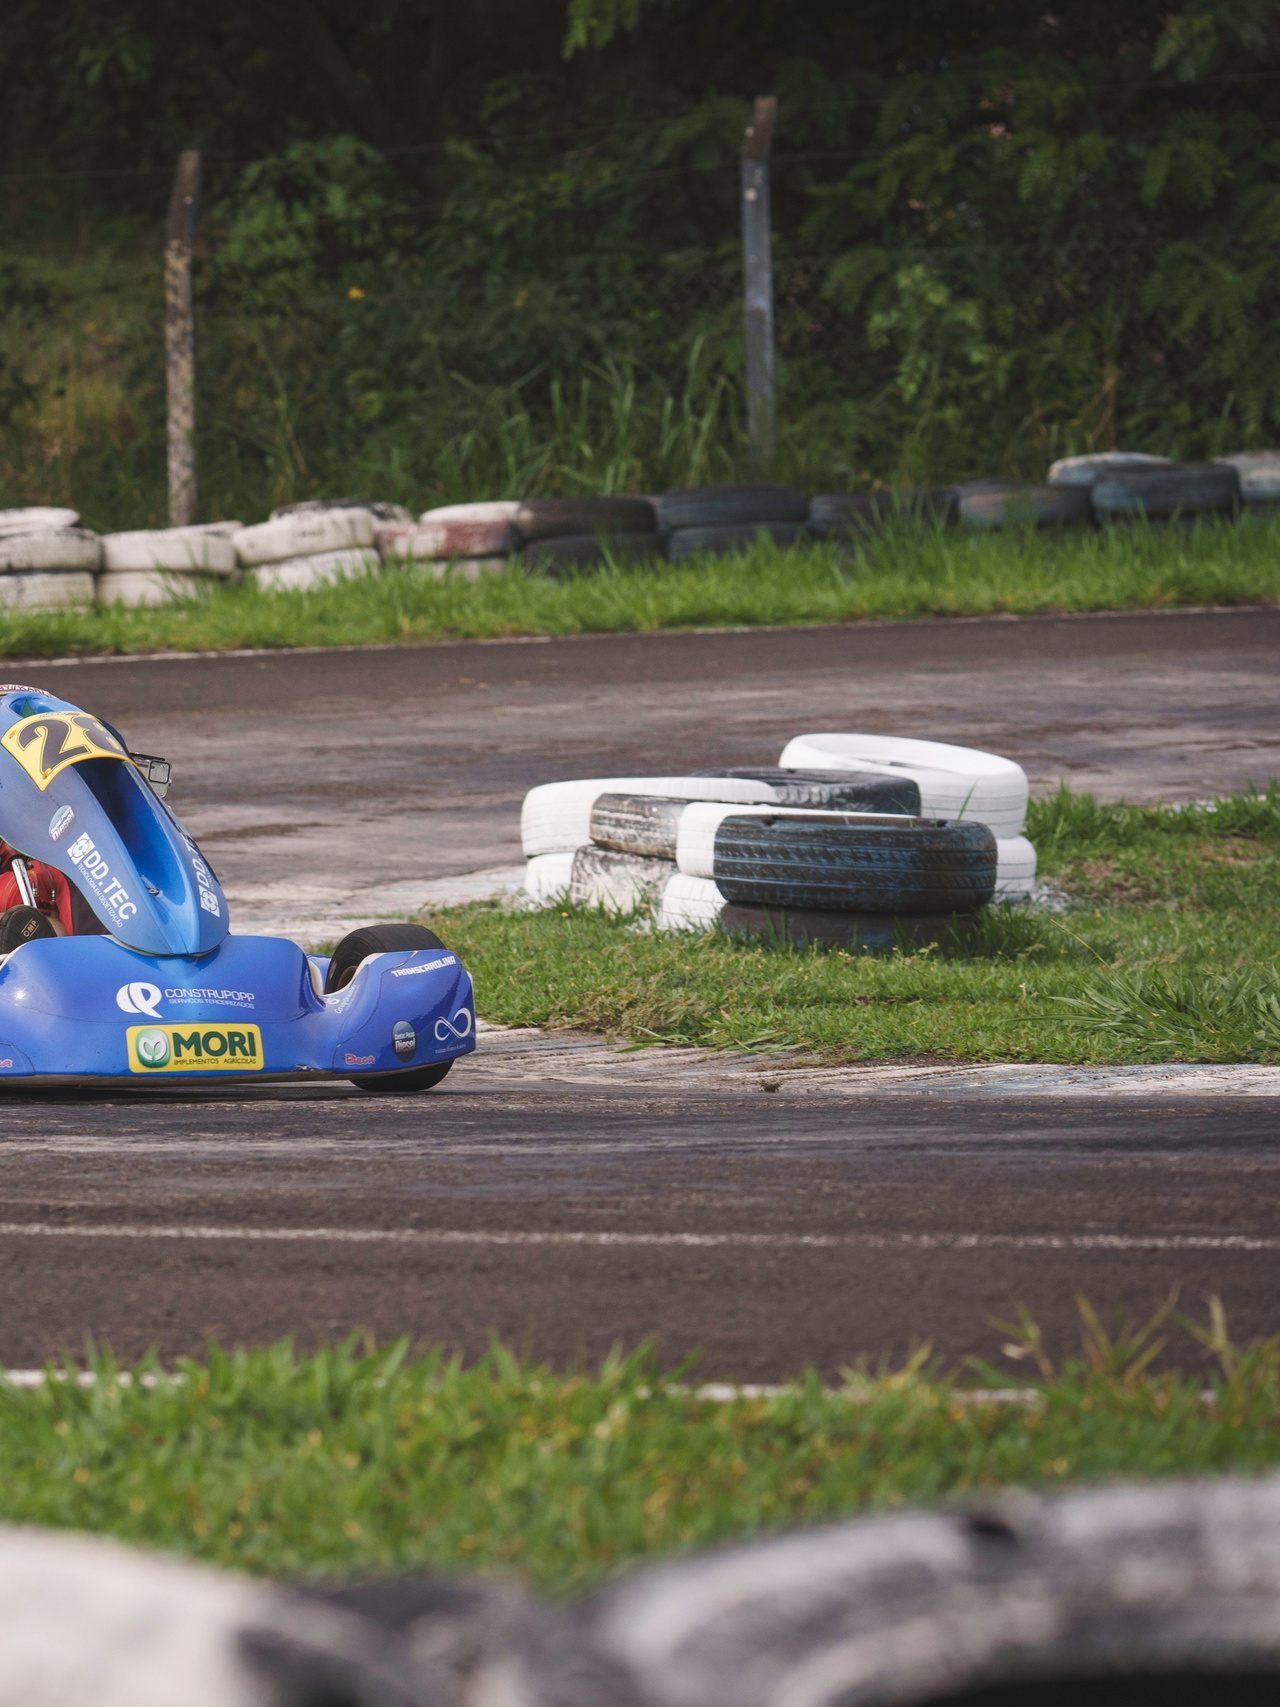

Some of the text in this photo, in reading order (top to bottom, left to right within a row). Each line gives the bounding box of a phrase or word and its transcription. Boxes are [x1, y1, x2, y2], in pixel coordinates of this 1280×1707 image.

[17, 716, 127, 775] 28
[83, 850, 137, 920] DD.TEC
[391, 955, 457, 977] TRANSCAROLINA
[164, 988, 255, 1002] CONSTRUPOPP
[172, 1031, 257, 1057] MORI
[223, 1056, 257, 1065] AGRÍCOLAS
